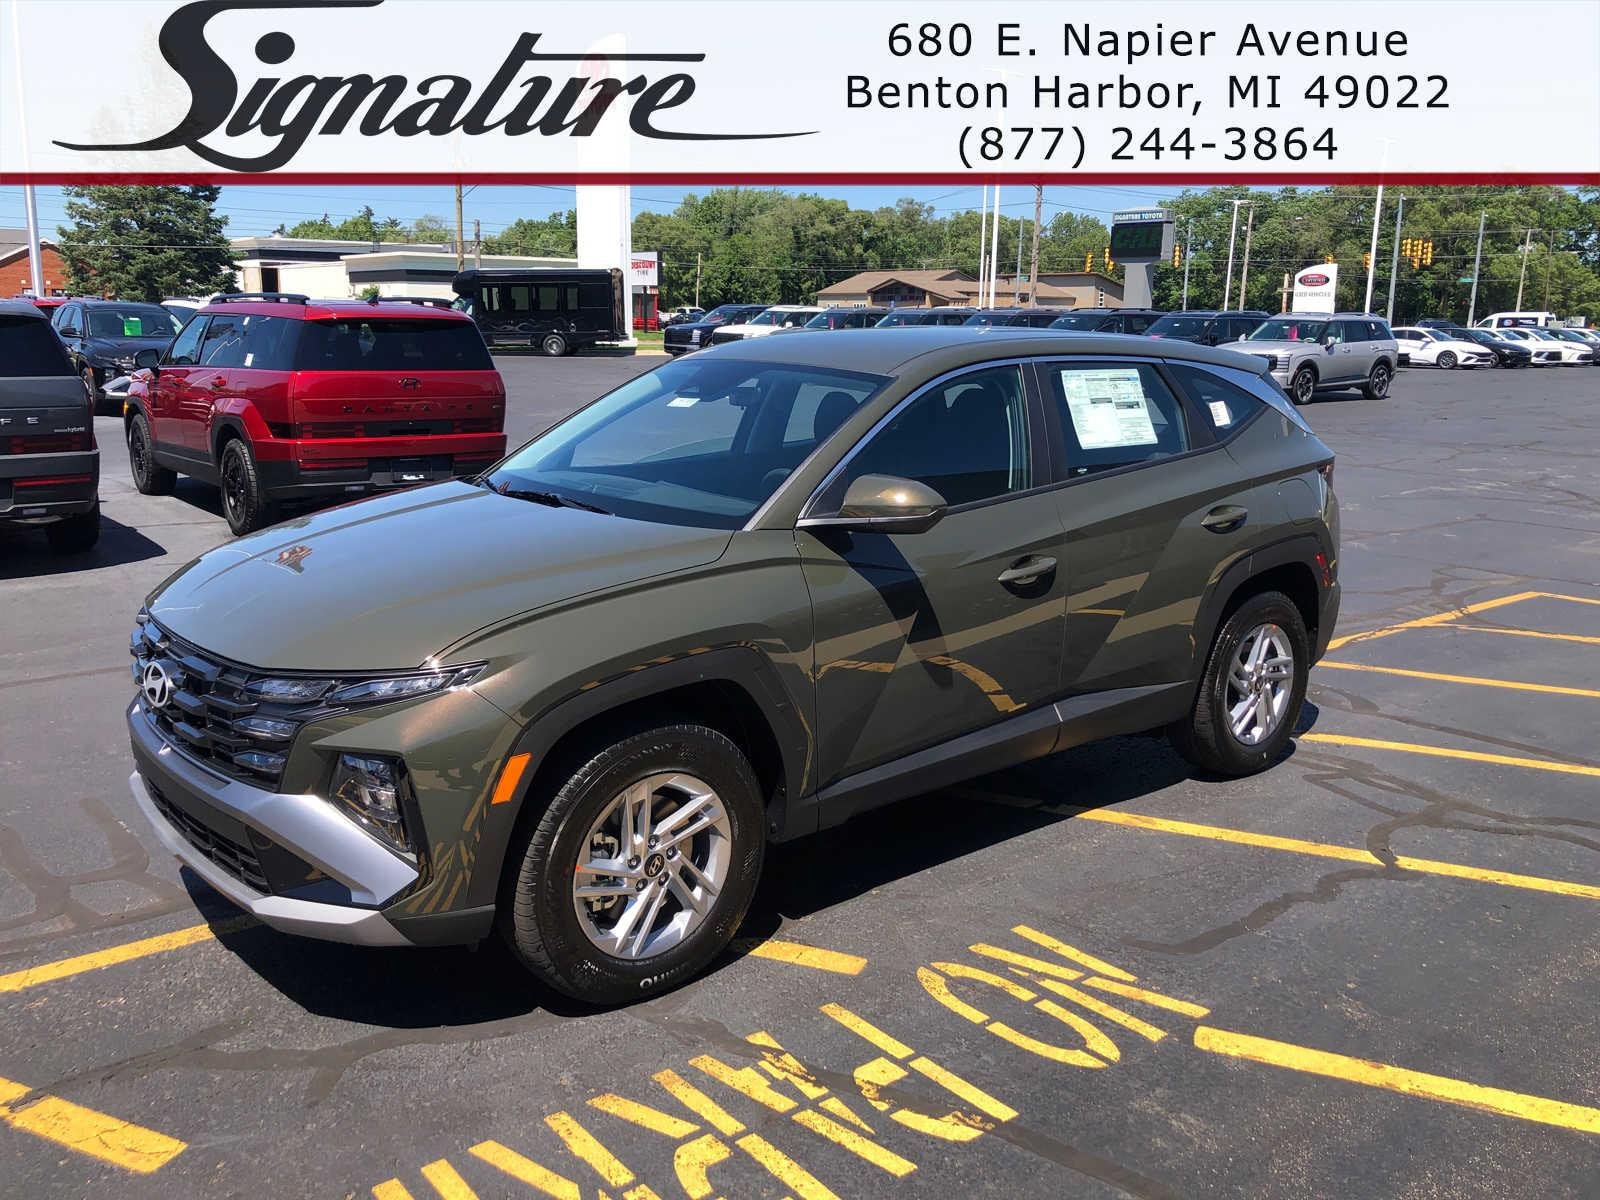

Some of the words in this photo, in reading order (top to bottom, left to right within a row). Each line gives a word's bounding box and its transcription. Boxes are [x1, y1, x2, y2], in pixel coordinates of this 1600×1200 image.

[1142, 212, 1163, 220] TOYOTA
[0, 417, 39, 425] FE
[917, 925, 1210, 1069] NO
[372, 1004, 1018, 1200] PARK
